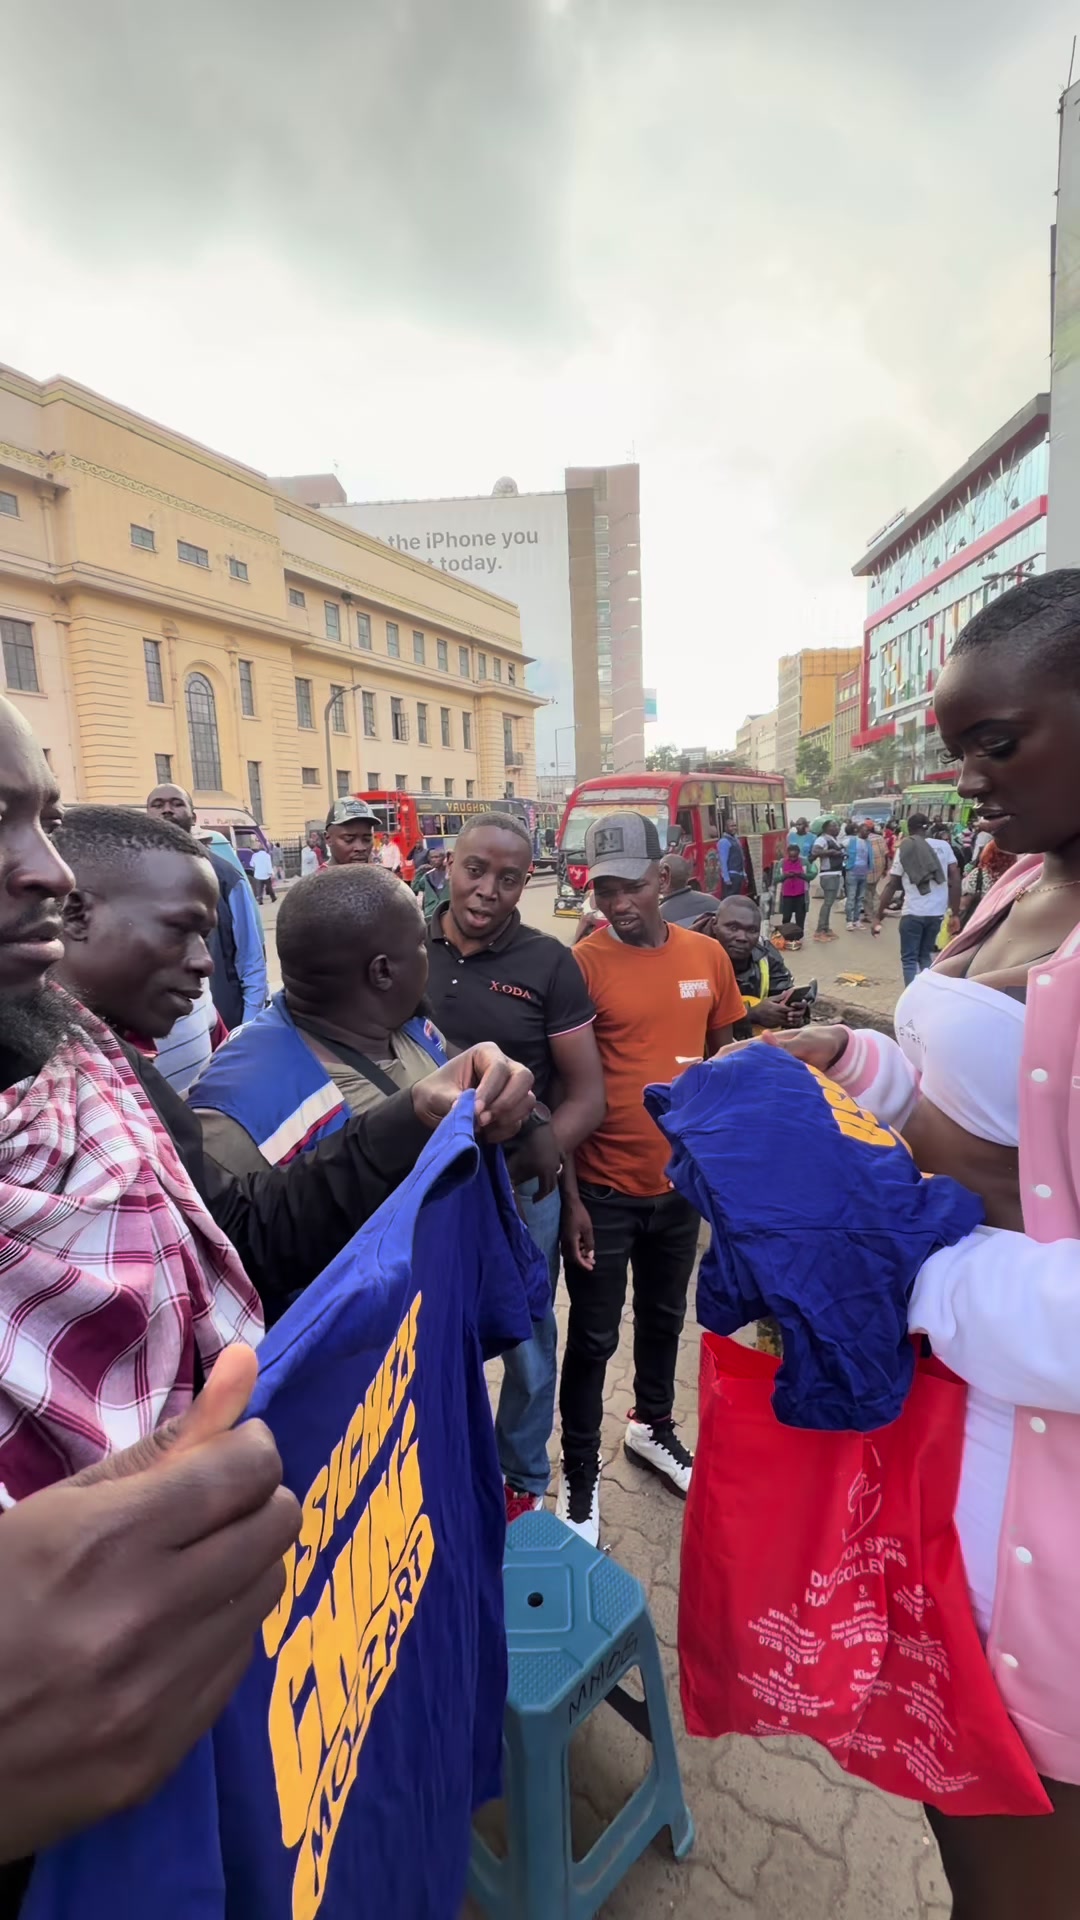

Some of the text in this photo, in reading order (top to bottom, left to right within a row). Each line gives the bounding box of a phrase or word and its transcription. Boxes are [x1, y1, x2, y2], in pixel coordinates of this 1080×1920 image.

[387, 530, 539, 550] the iPhone you
[440, 555, 502, 574] today.
[446, 801, 492, 813] VAUGHAN
[489, 980, 532, 1000] X.ODA
[680, 989, 696, 999] DAY
[758, 1635, 783, 1652] 0729
[752, 1687, 776, 1707] 0729
